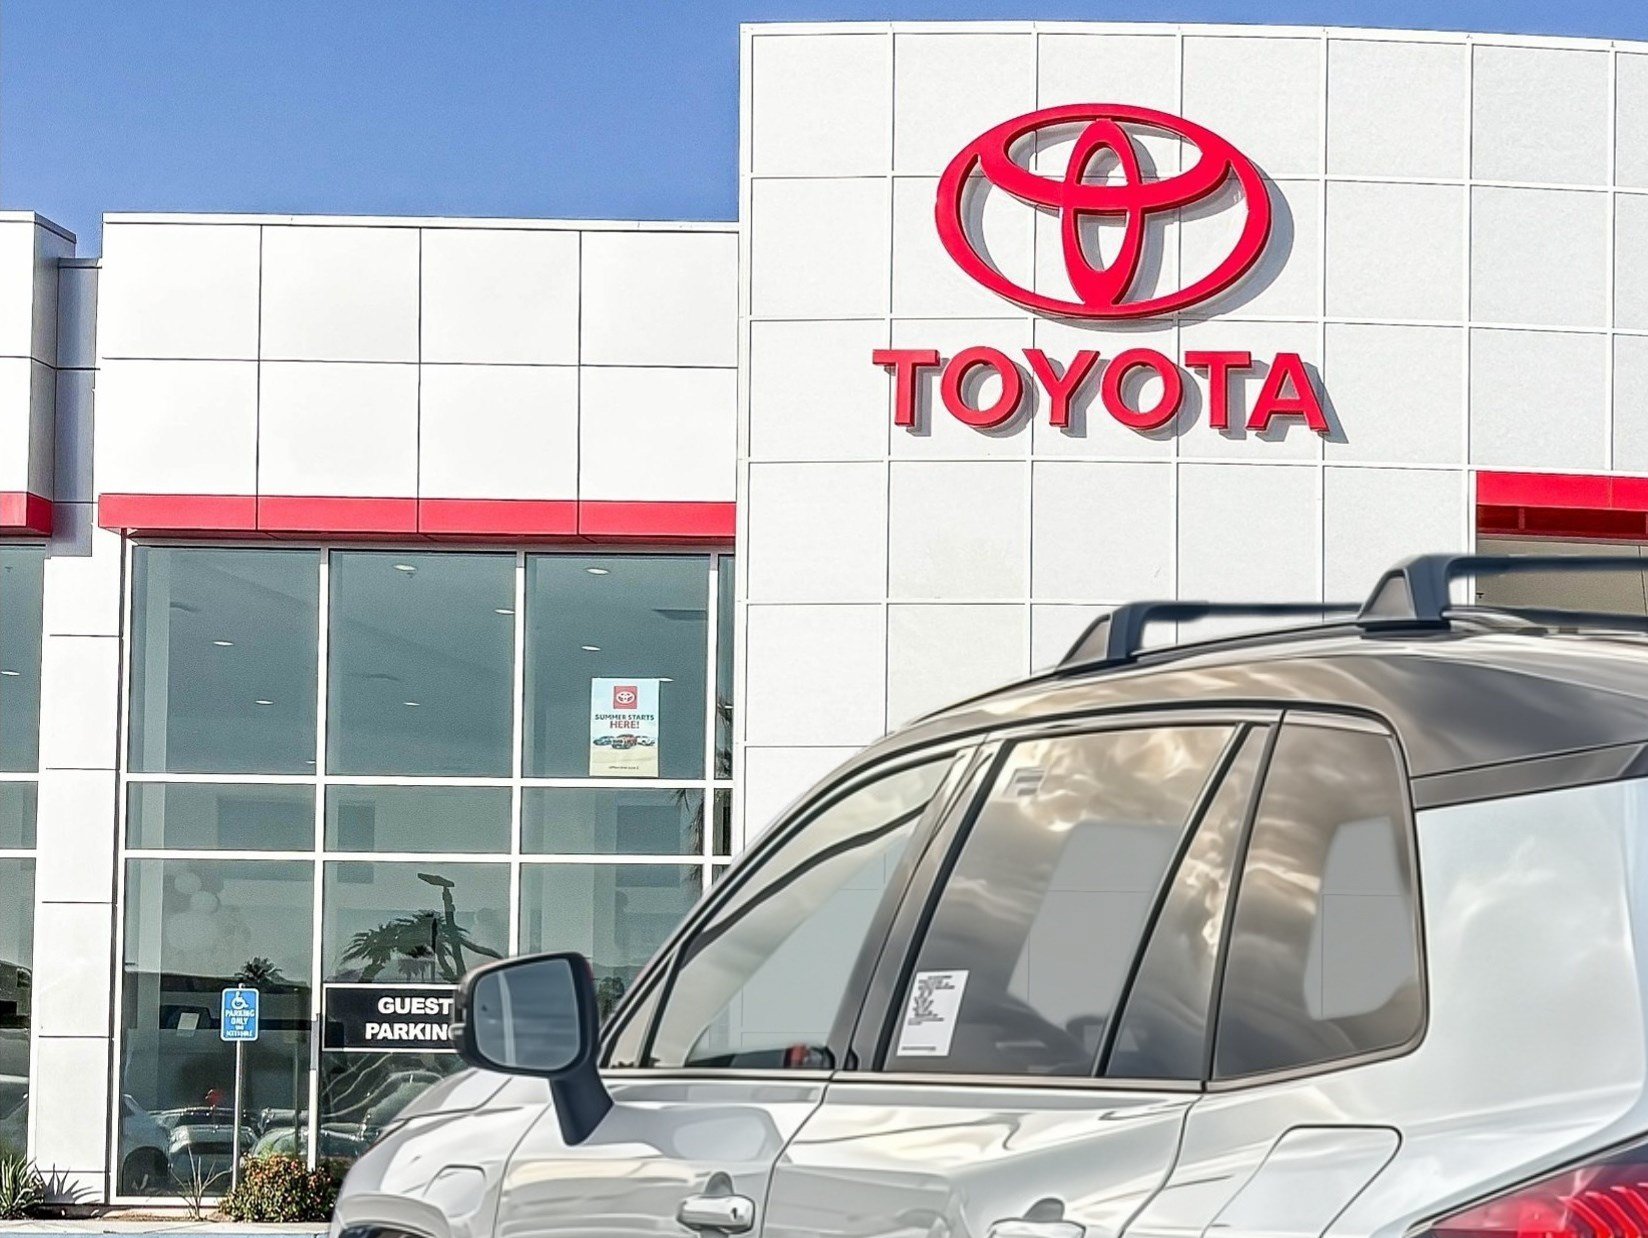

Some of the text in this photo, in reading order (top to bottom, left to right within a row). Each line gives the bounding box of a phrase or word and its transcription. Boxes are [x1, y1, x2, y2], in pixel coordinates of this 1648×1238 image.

[871, 346, 1330, 433] TOYOTA
[609, 721, 640, 729] HERE!
[377, 997, 454, 1014] GUEST
[230, 1017, 249, 1025] ONLY
[365, 1023, 451, 1041] PARKIN
